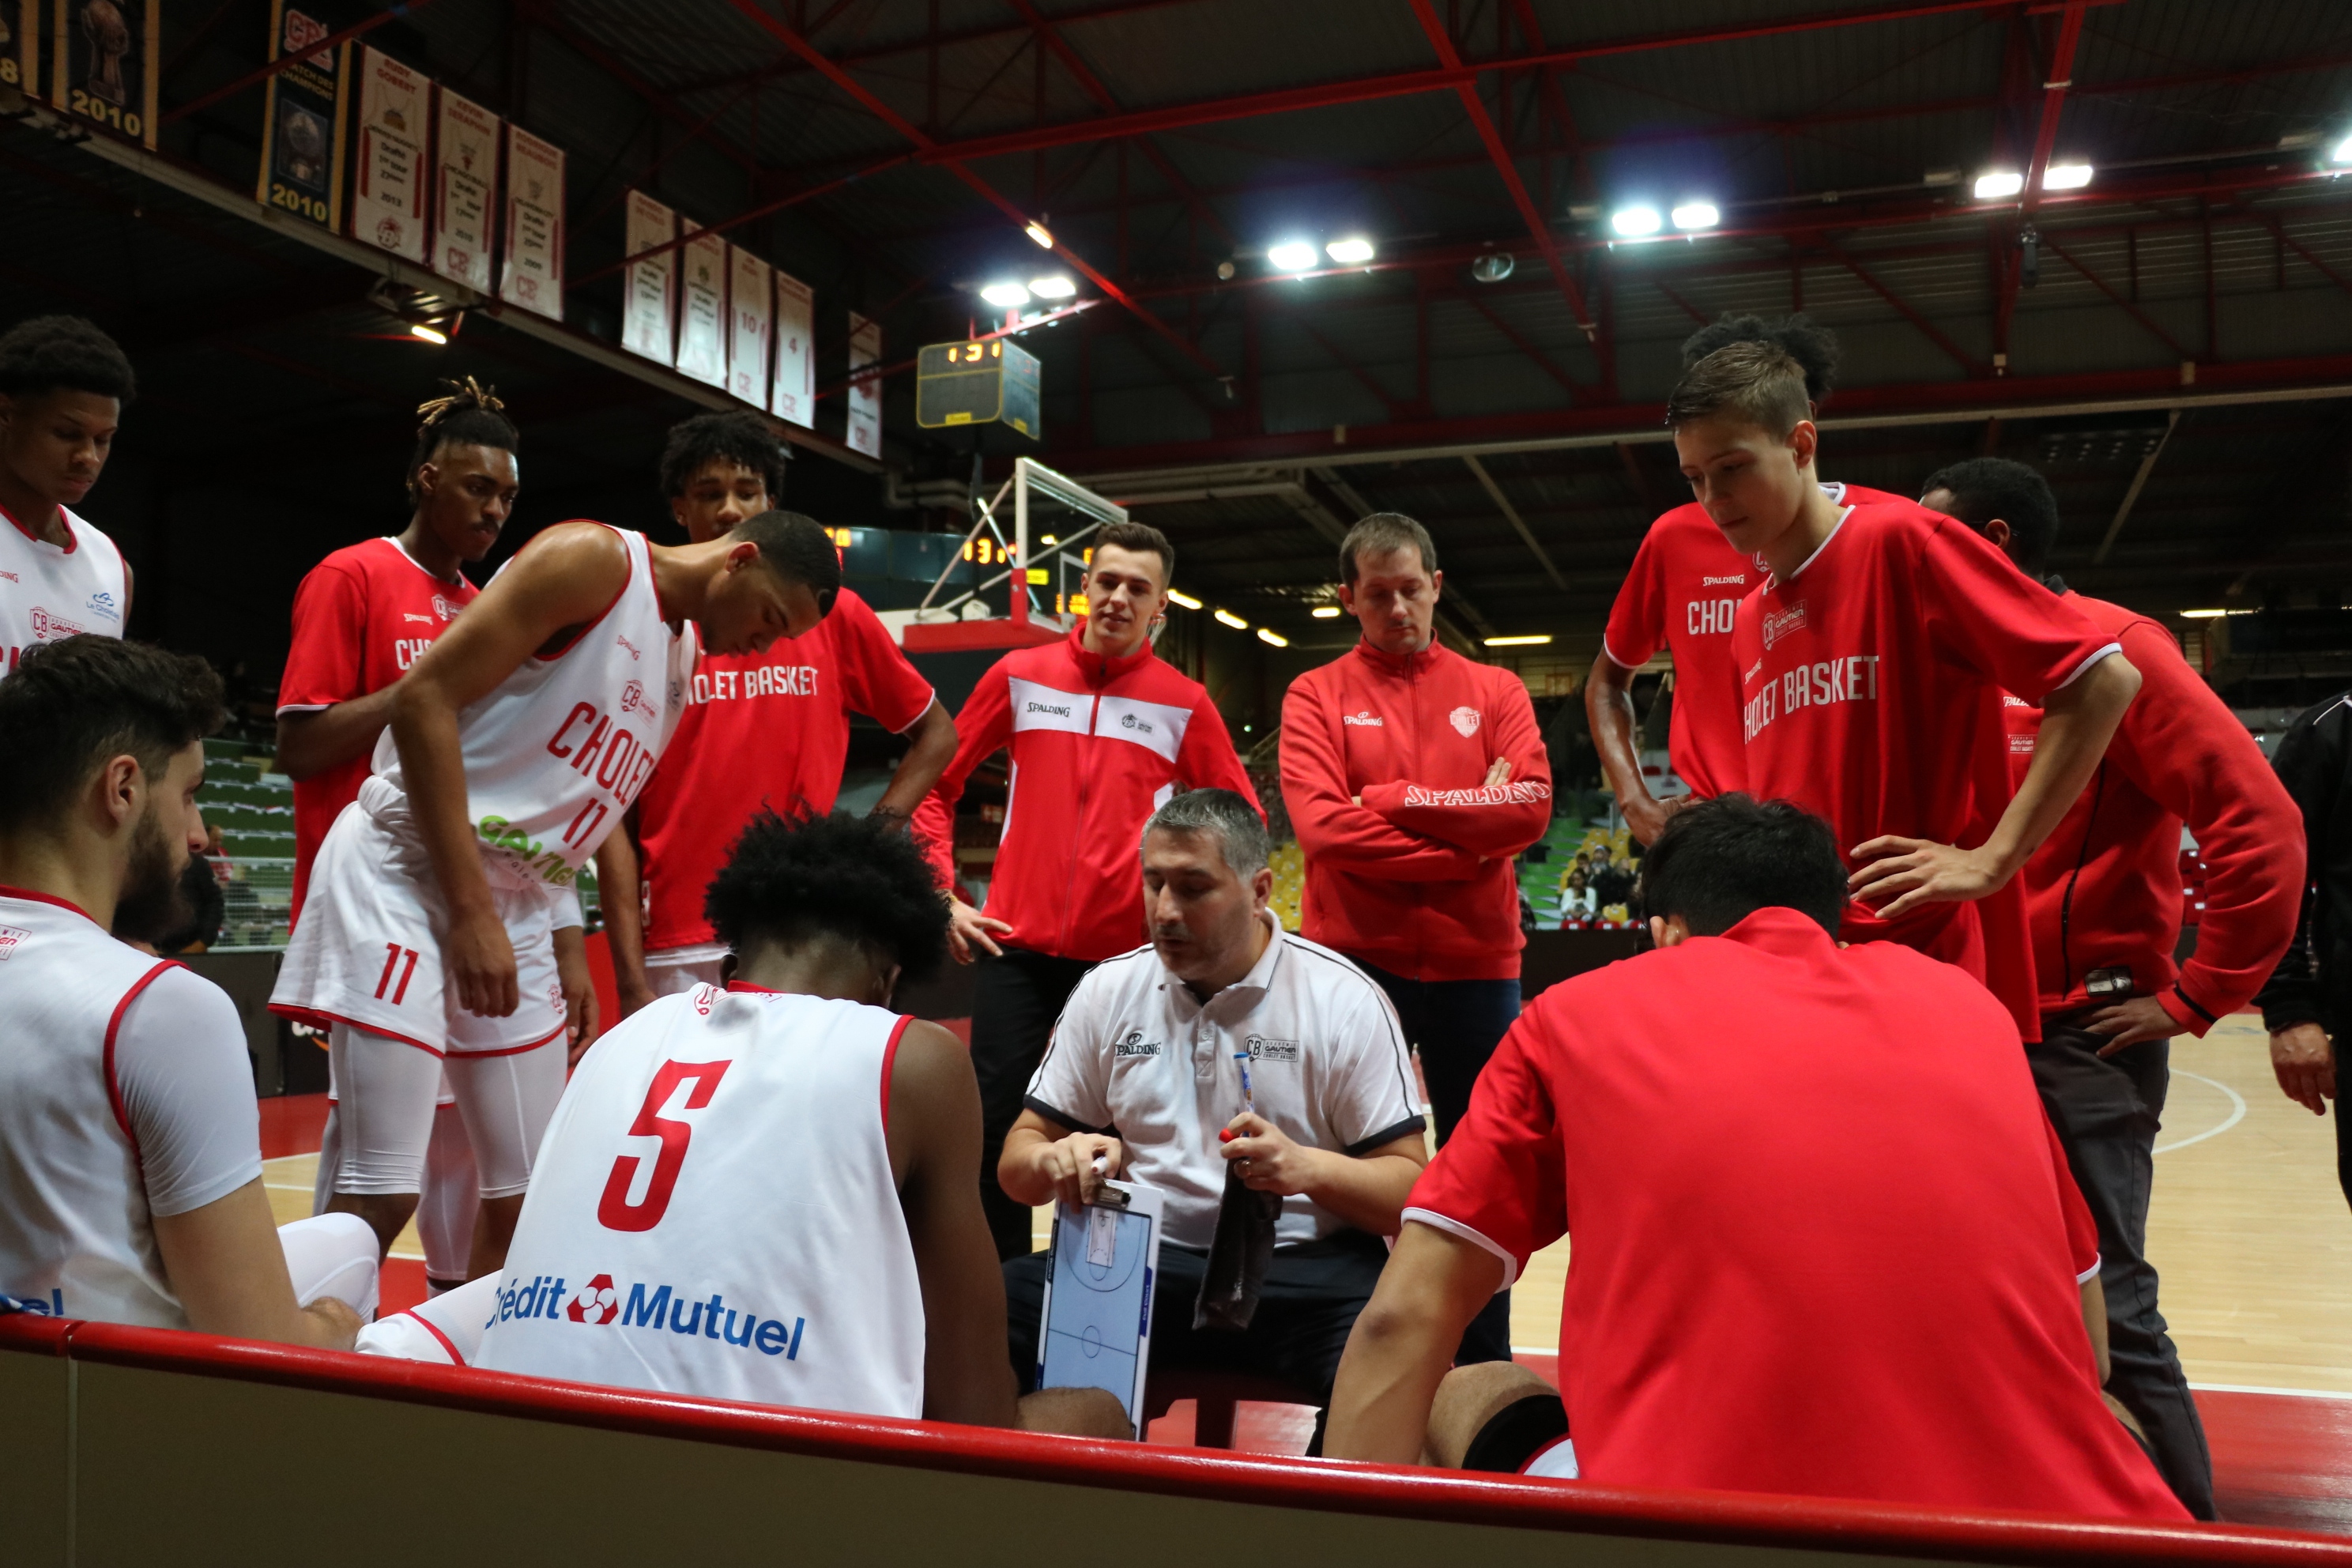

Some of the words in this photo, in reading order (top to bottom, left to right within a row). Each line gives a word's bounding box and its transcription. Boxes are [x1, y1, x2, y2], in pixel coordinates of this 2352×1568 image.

[290, 62, 317, 81] ATCH
[72, 89, 141, 138] 2010
[271, 183, 327, 222] 2010
[741, 312, 756, 334] 10
[789, 337, 797, 354] 4
[1703, 574, 1745, 587] SPALDING
[1687, 599, 1743, 635] CHO
[688, 670, 740, 706] OET
[744, 666, 819, 699] BASKET
[1784, 654, 1879, 715] BASKET
[1027, 702, 1071, 718] SPALDING
[563, 797, 608, 850] 11
[374, 942, 420, 1005] 11
[1115, 1042, 1162, 1057] PALDING
[597, 1057, 733, 1233] 5
[621, 1282, 806, 1361] Mutuel
